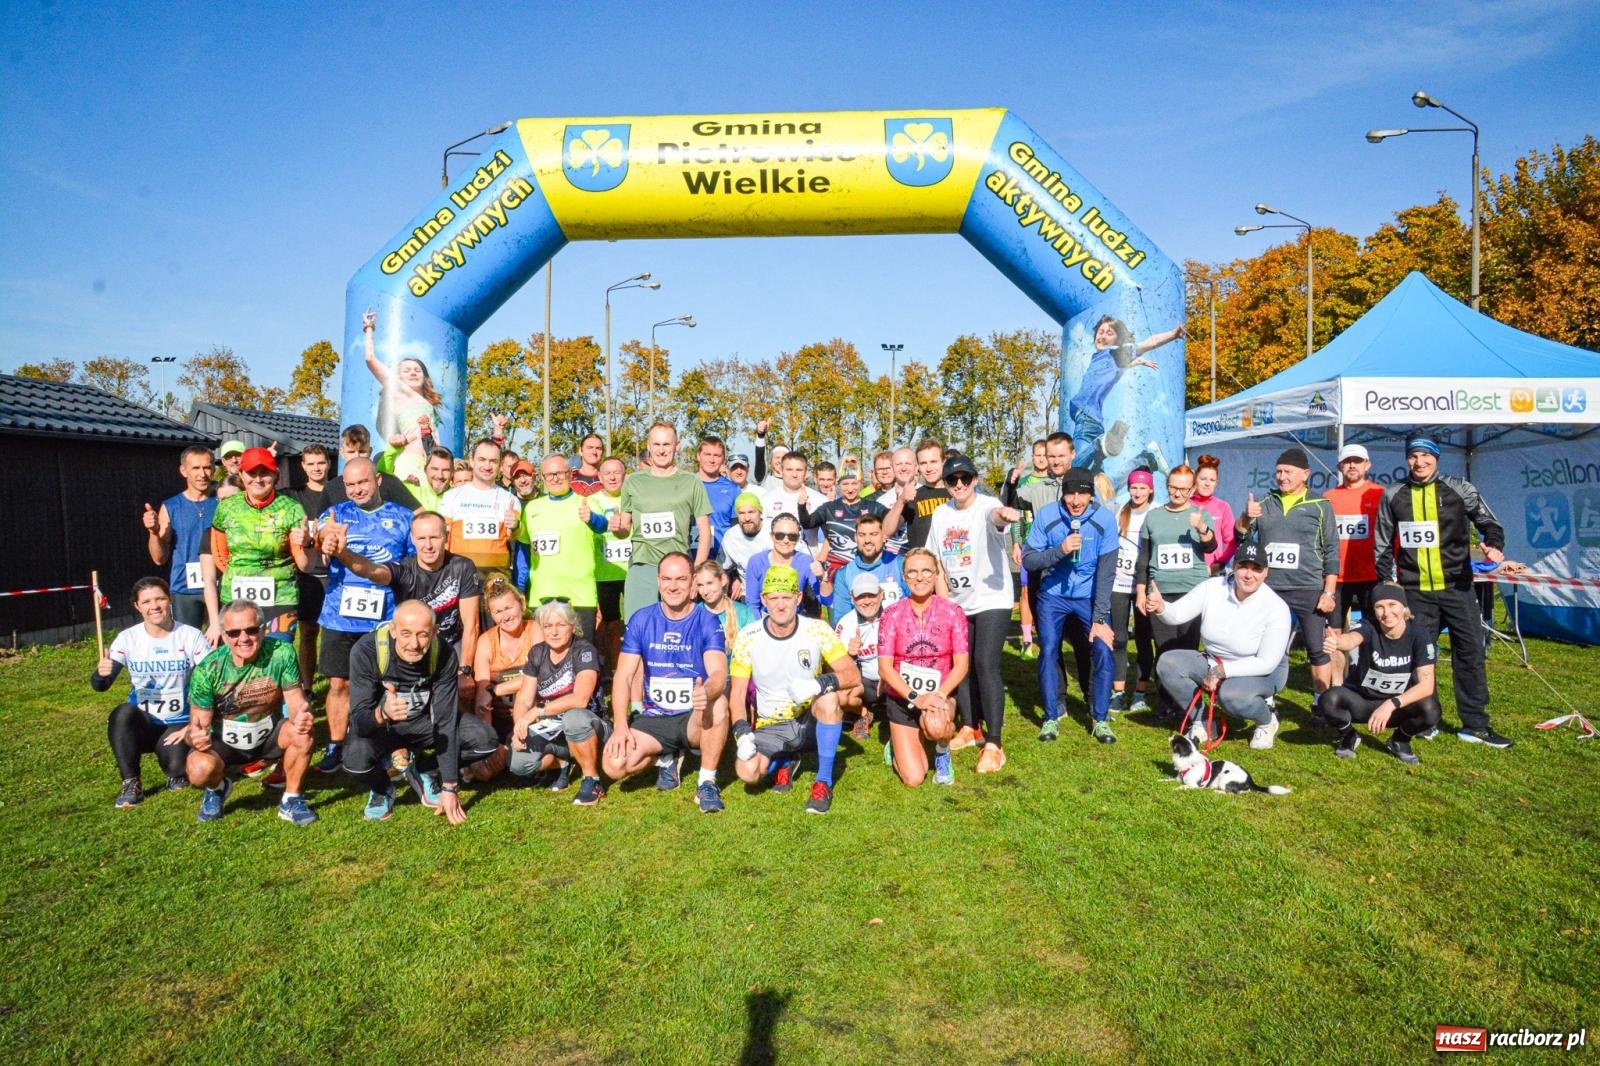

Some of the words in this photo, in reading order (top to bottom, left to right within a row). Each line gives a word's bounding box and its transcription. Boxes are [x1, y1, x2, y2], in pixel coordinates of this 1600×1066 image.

[692, 119, 822, 137] Gmina
[682, 168, 831, 195] Wielkie
[380, 206, 455, 276] Gmina
[450, 149, 514, 211] ludzi
[1008, 141, 1084, 214] Gmina
[1080, 207, 1147, 270] ludzi
[407, 176, 535, 297] aktywnych
[985, 170, 1115, 293] aktywnych
[1365, 389, 1503, 411] PersonalBest
[465, 522, 497, 535] 338
[643, 520, 673, 534] 303
[1337, 523, 1366, 535] 165
[1402, 530, 1435, 543] 159
[532, 540, 557, 553] 337
[605, 547, 631, 558] 315
[1160, 552, 1191, 564] 318
[1267, 551, 1297, 564] 149
[233, 586, 271, 601] 180
[344, 597, 379, 613] 151
[901, 672, 937, 692] 309
[1368, 677, 1406, 690] 157
[653, 689, 690, 704] 305
[140, 698, 181, 713] 178
[226, 728, 270, 745] 312
